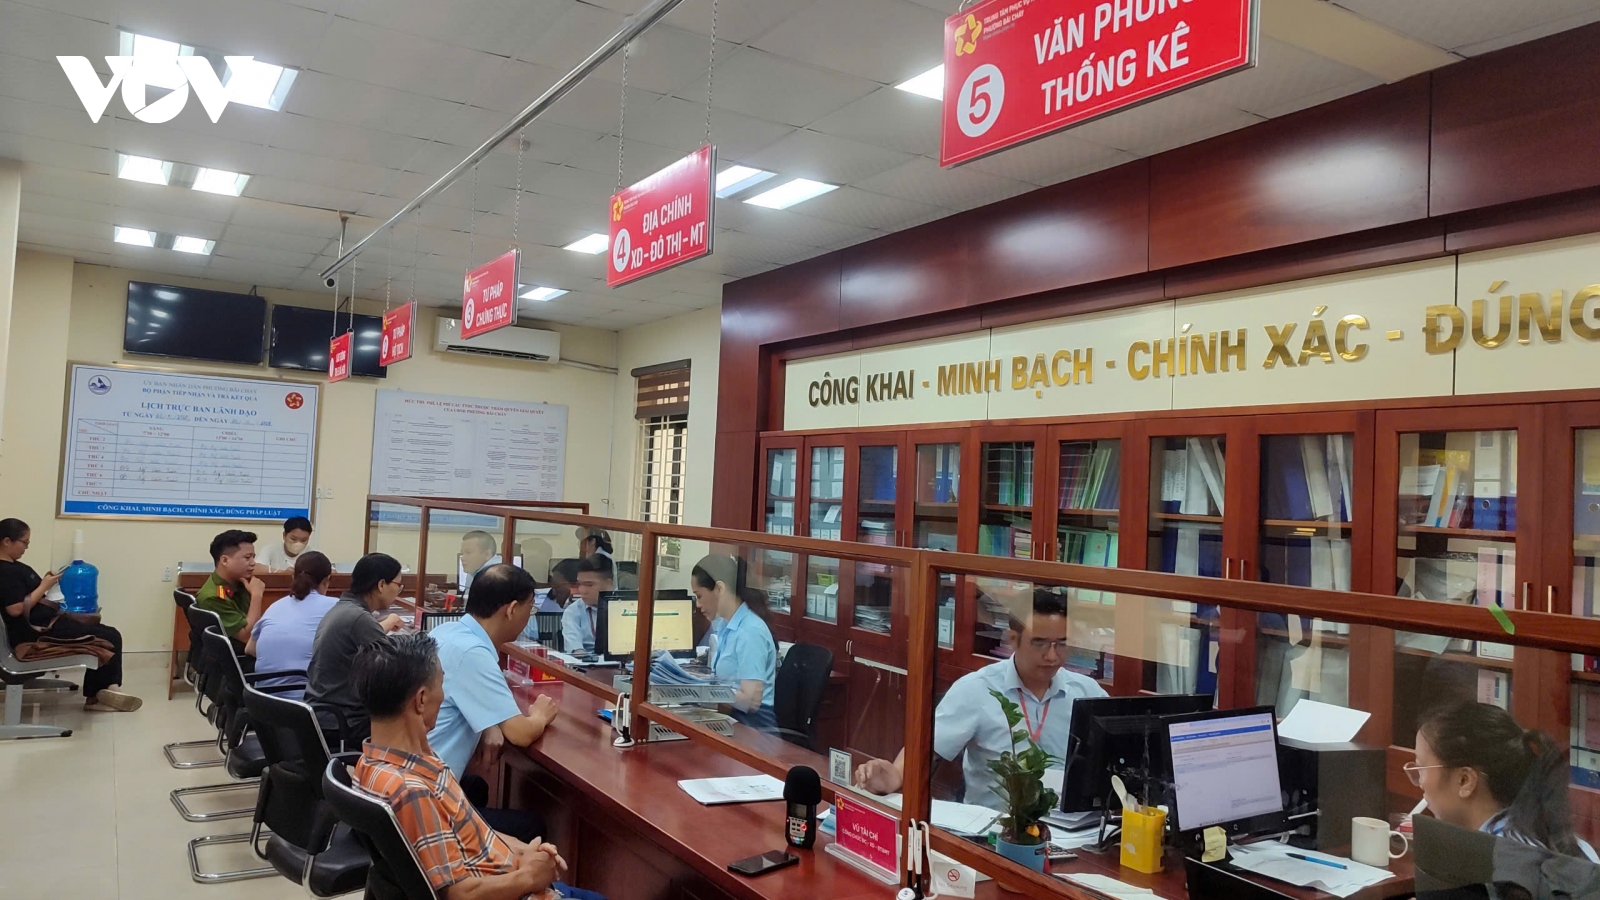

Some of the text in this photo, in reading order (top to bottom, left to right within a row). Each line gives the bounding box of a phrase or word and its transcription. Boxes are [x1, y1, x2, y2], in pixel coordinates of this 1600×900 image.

[983, 20, 1003, 35] PHƯỜNG
[1003, 15, 1012, 26] BÃI
[1012, 9, 1025, 22] CHÁY
[984, 12, 999, 25] TRUNG
[999, 7, 1010, 17] TÂM
[1034, 13, 1085, 65] VĂN
[1041, 21, 1191, 115] THỐNG KÊ
[968, 75, 992, 126] 5
[642, 208, 659, 236] ĐỊA
[660, 192, 692, 226] CHÍNH
[616, 235, 627, 264] 4
[666, 230, 682, 257] THỊ
[690, 221, 705, 247] MT
[490, 280, 503, 301] PHÁP
[475, 302, 508, 328] CHỨNG THỰC
[808, 371, 860, 408] CÔNG
[866, 369, 915, 401] KHAI
[936, 358, 1003, 396] MINH
[1011, 347, 1094, 399] BẠCH
[1127, 322, 1248, 381] CHÍNH
[1262, 304, 1371, 369] XÁC
[1422, 280, 1600, 355] ĐÚNG
[142, 386, 152, 394] BỘ
[153, 387, 172, 395] PHẬN
[172, 388, 188, 396] TIẾP
[188, 390, 207, 398] NHẬN
[230, 392, 244, 401] KẾT
[133, 410, 154, 419] NGÀY
[209, 417, 229, 425] NGÀY
[140, 400, 165, 411] LỊCH
[165, 402, 192, 412] TRỰC
[192, 405, 212, 413] BAN
[212, 406, 237, 415] LÃNH
[97, 503, 119, 511] CÔNG
[185, 506, 208, 514] CHÍNH
[208, 507, 225, 515] XÁC,
[245, 508, 263, 516] PHÁP
[852, 822, 860, 833] VŨ
[860, 825, 869, 837] TÀI
